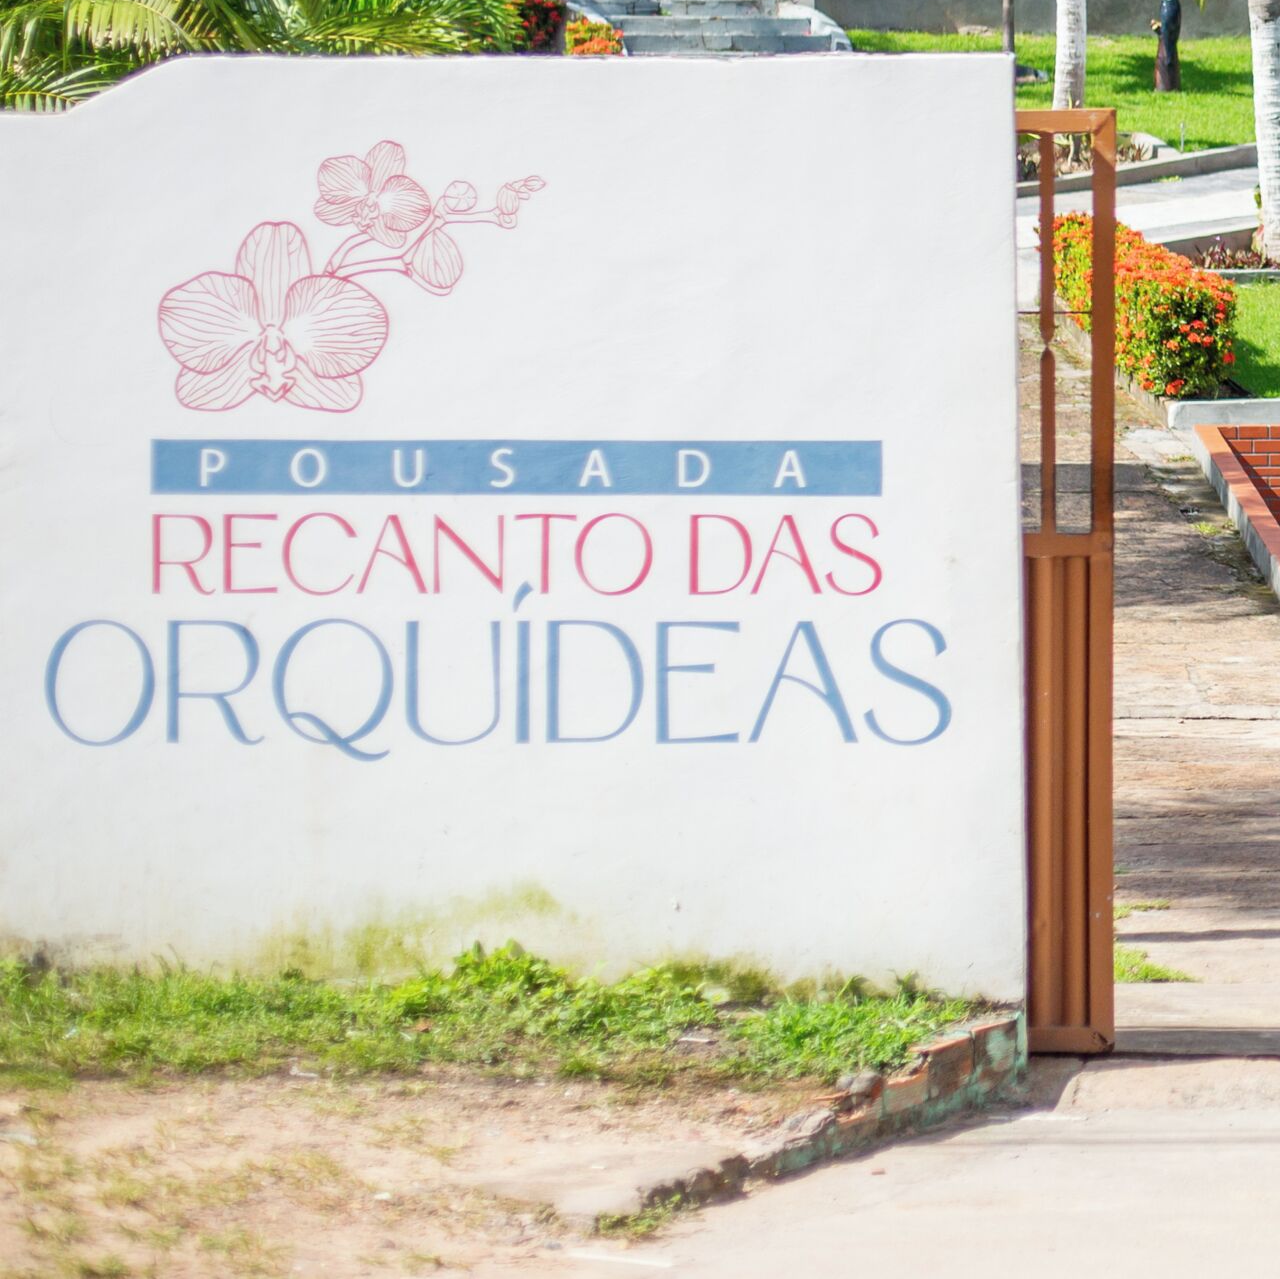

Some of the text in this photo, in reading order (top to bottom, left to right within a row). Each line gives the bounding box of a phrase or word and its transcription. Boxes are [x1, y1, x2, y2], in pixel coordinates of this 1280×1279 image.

[199, 447, 807, 488] POUSADA
[153, 513, 884, 595] RECANTO DAS
[44, 583, 952, 762] ORQUÍDEAS
